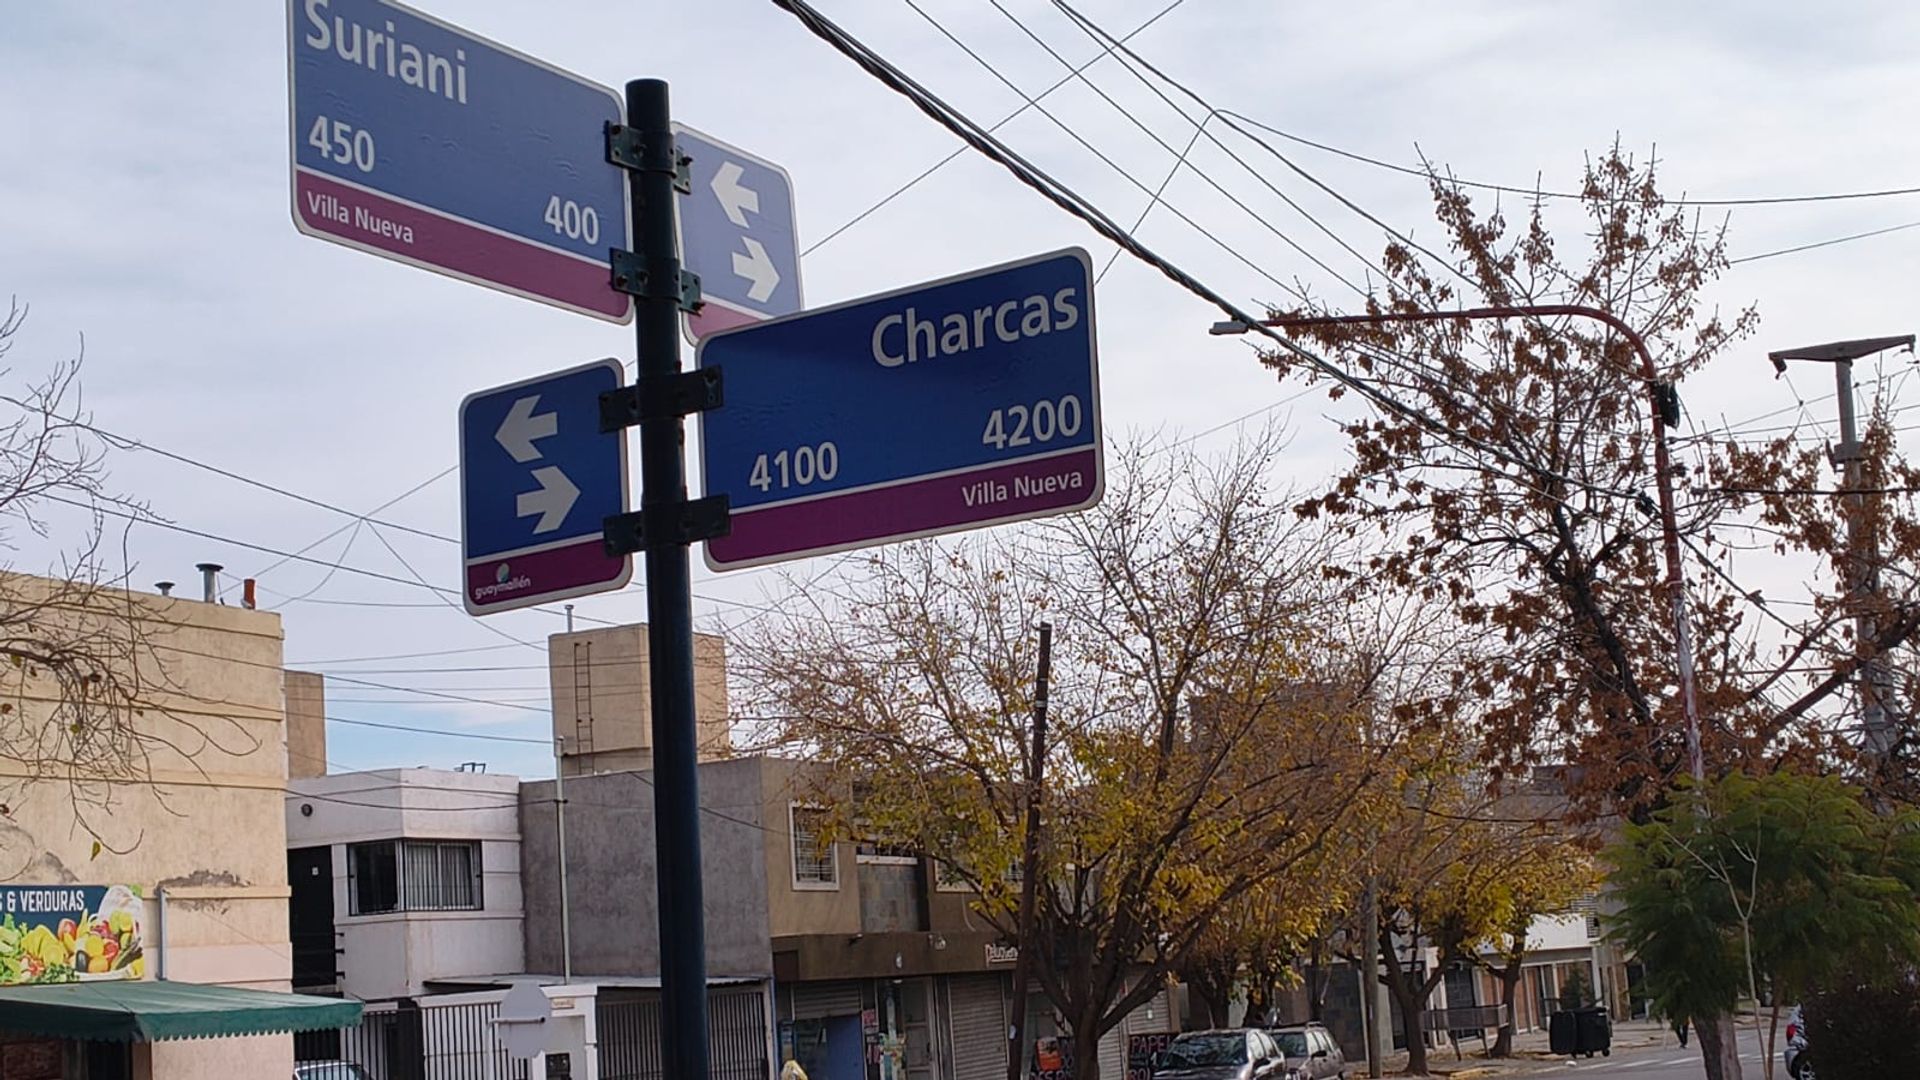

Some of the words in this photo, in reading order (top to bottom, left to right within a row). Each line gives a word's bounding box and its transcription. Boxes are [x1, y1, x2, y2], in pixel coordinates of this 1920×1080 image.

[305, 0, 468, 104] Suriani
[309, 115, 375, 174] 450
[307, 190, 350, 225] Villa
[355, 207, 414, 245] Nueva
[544, 195, 599, 246] 400
[872, 287, 1079, 368] Charcas
[982, 394, 1083, 450] 4200
[749, 441, 839, 493] 4100
[961, 482, 1008, 507] Villa
[1014, 470, 1084, 499] Nueva
[7, 891, 16, 912] &
[20, 889, 84, 913] VERDURAS
